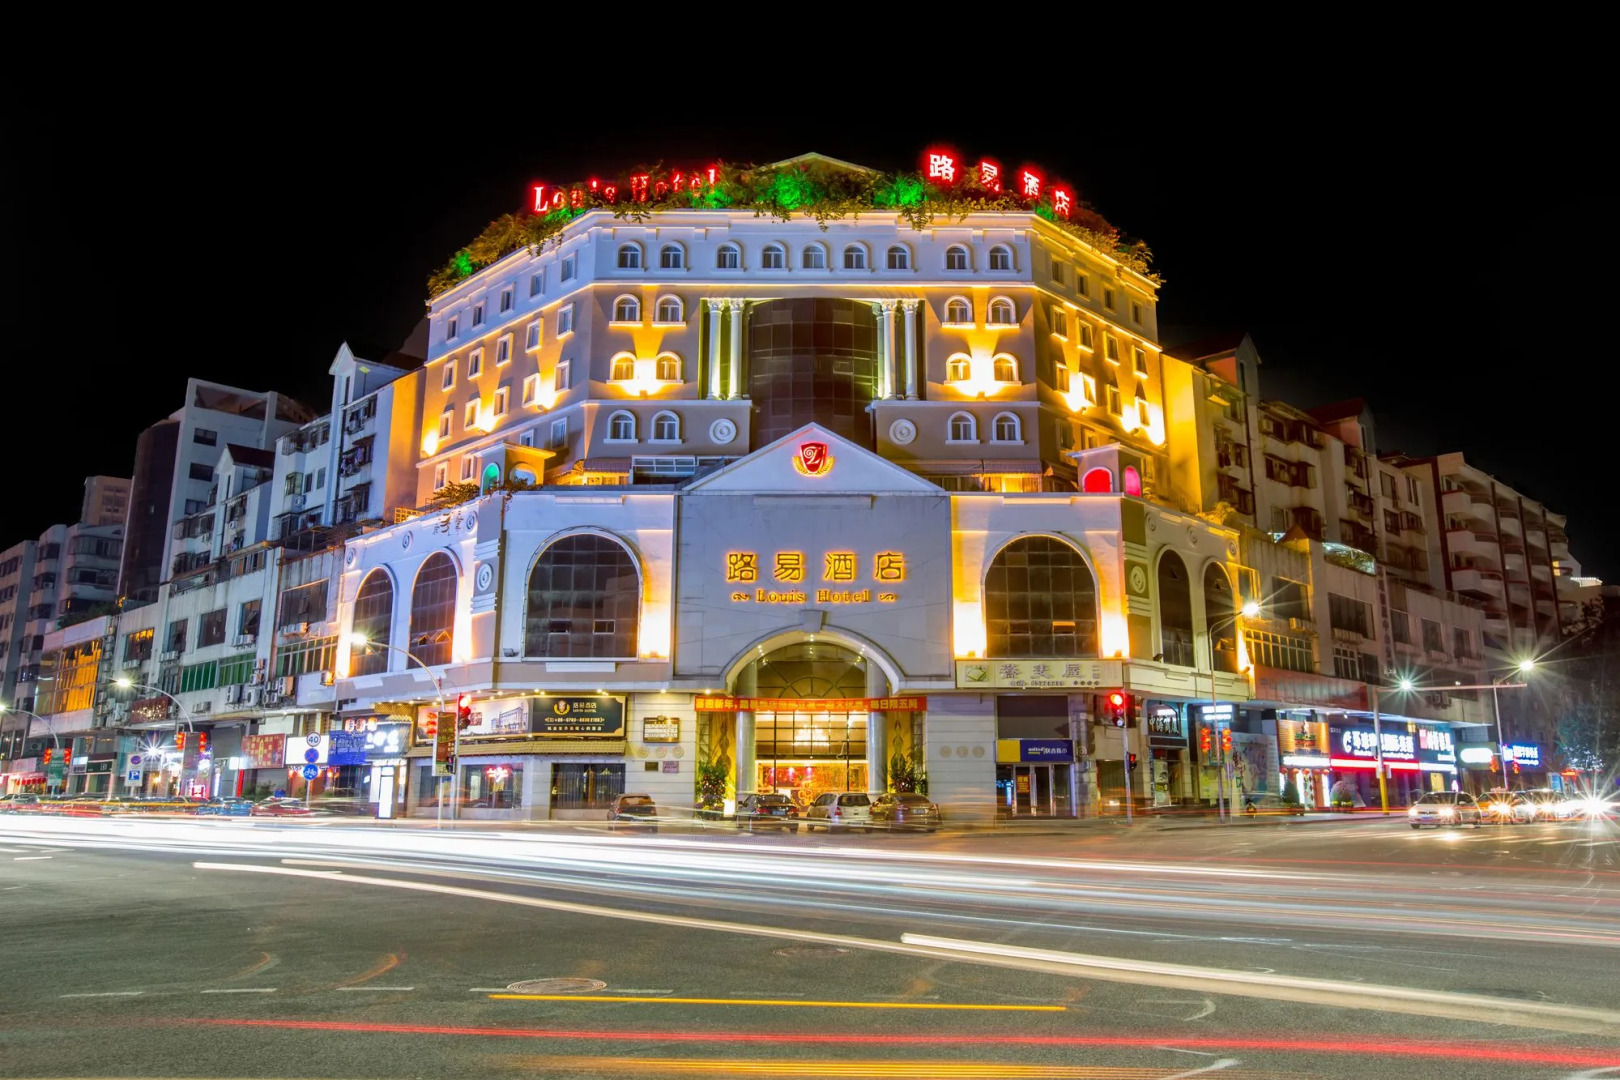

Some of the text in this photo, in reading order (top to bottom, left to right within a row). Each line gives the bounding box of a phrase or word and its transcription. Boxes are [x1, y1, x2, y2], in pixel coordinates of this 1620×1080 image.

[726, 552, 905, 582] 路易酒店
[756, 589, 871, 602] Louis Hotel
